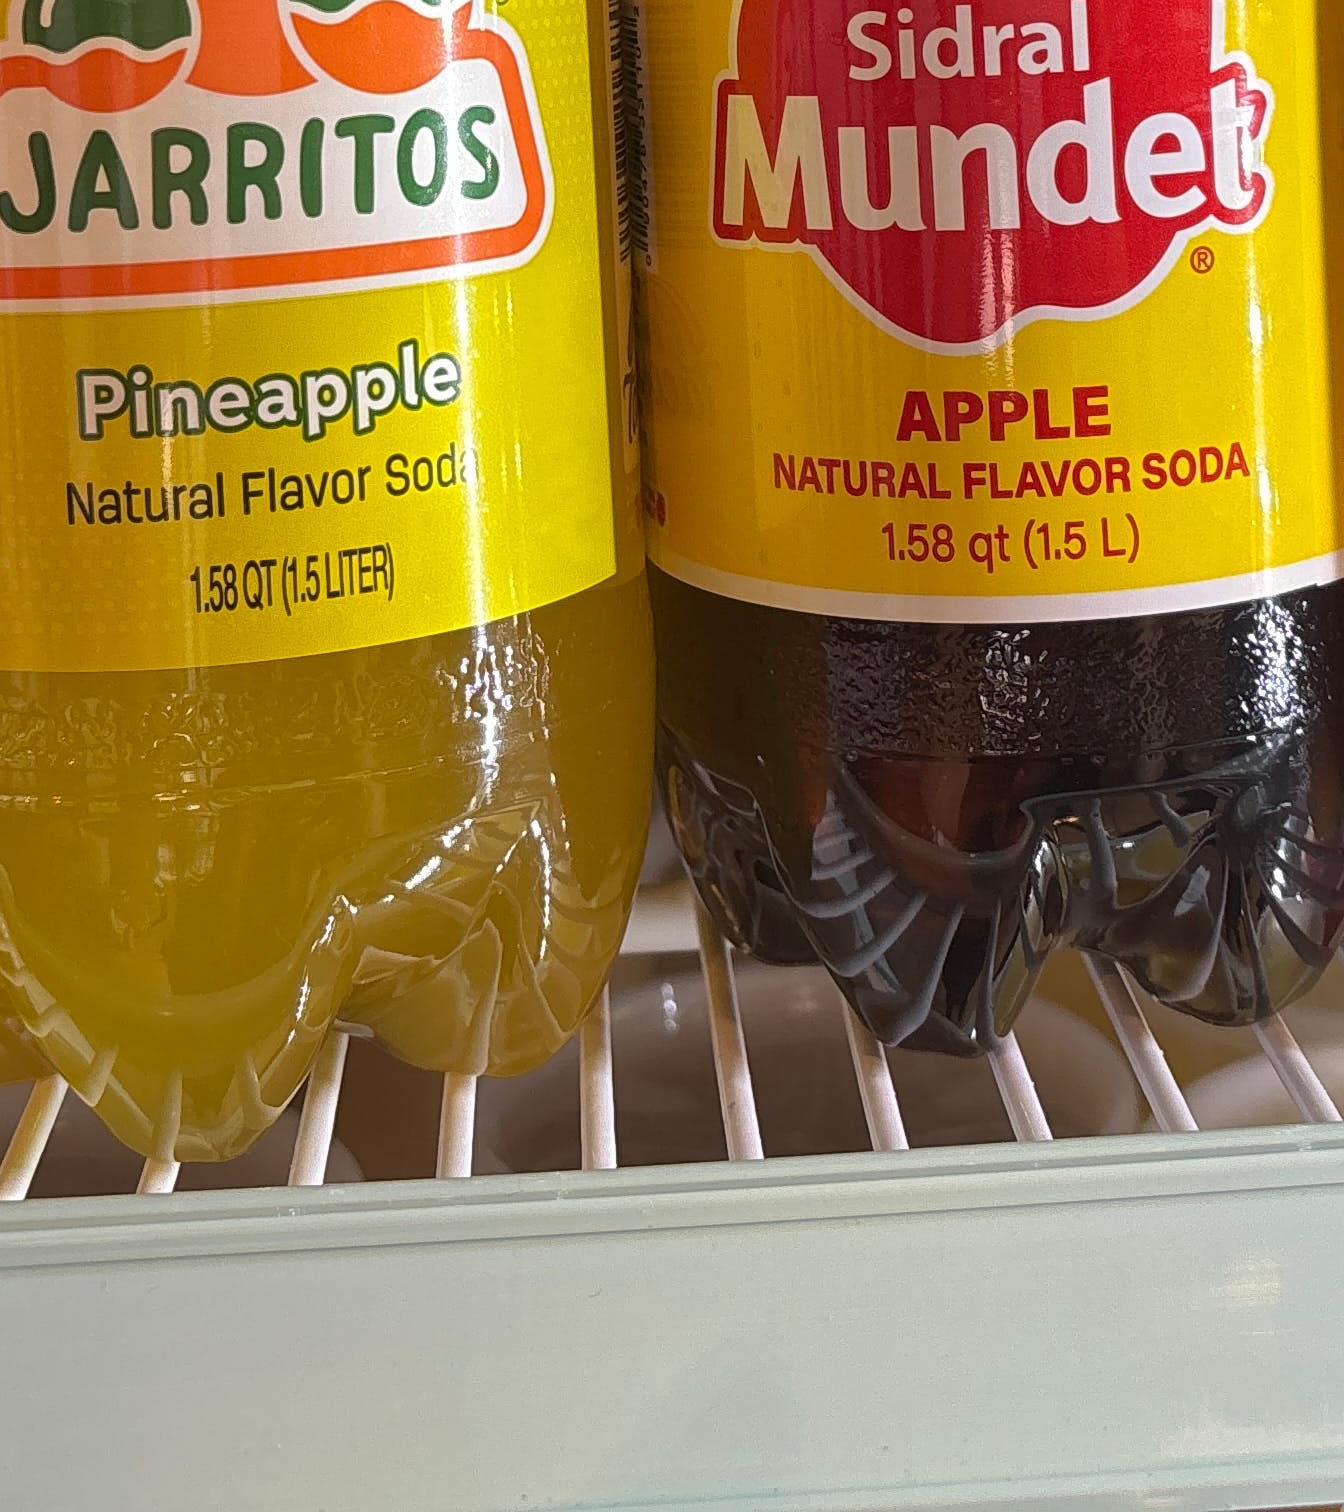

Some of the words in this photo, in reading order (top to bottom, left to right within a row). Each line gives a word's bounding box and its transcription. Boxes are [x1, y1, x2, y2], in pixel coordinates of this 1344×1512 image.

[724, 77, 1259, 232] Mundet
[76, 338, 461, 441] Pineapple
[895, 385, 1112, 443] APPLE
[65, 473, 226, 526] Natural
[242, 453, 371, 514] Flavor
[386, 441, 479, 496] Soda
[771, 451, 953, 501] NATURAL
[963, 451, 1131, 501] FLAVOR
[1142, 440, 1251, 489] SODA
[190, 564, 239, 613] 1.58
[243, 559, 277, 610] QT
[282, 555, 320, 616] (1.5
[325, 542, 394, 601] LITER)
[882, 522, 955, 562] 1.58
[968, 524, 1010, 573] qt
[1024, 518, 1087, 569] (1.5
[1101, 513, 1139, 563] L)
